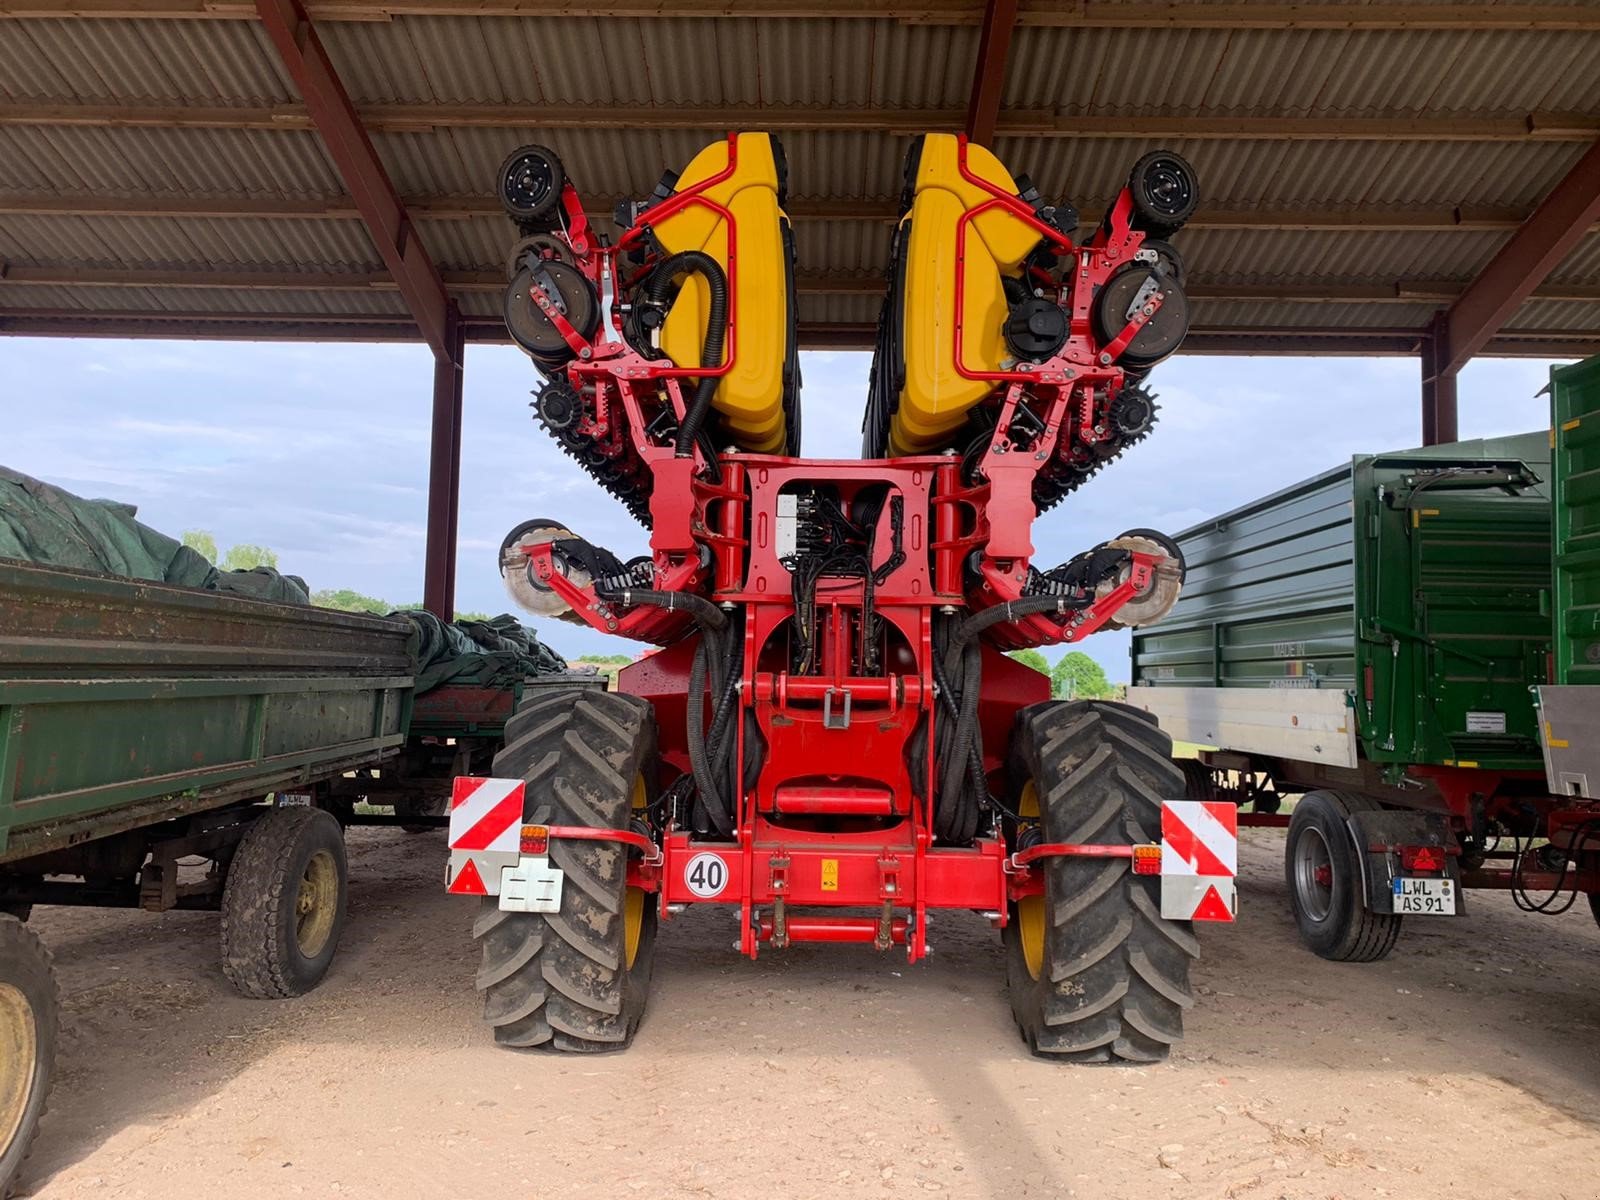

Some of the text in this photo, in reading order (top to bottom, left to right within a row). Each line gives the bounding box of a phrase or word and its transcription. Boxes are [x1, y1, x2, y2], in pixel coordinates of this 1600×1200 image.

[690, 861, 722, 889] 40
[1402, 880, 1432, 895] LWL
[1402, 897, 1444, 912] AS 91
